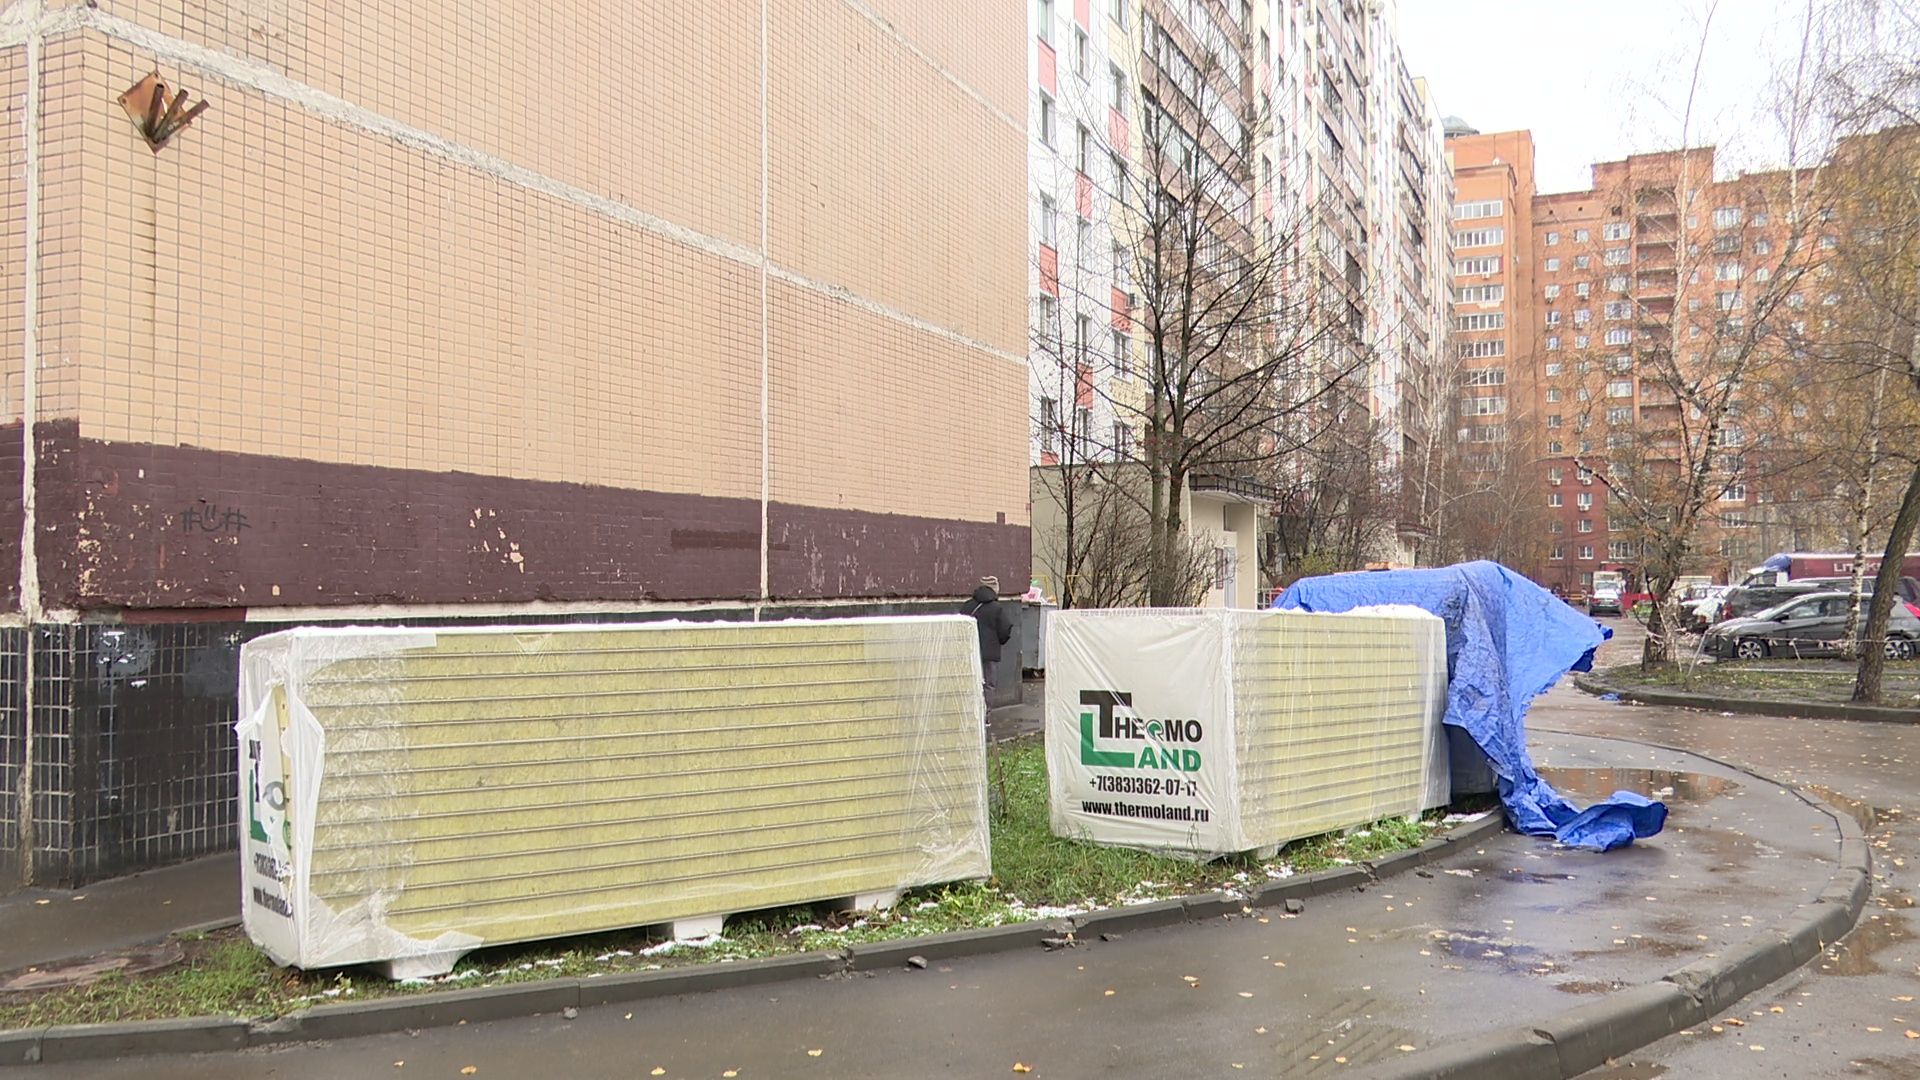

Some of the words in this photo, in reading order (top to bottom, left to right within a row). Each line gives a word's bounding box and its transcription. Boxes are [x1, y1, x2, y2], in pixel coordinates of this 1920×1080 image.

[1080, 690, 1203, 743] THERMO
[1080, 713, 1202, 772] LAND
[1082, 800, 1209, 823] www.thermoland.ru
